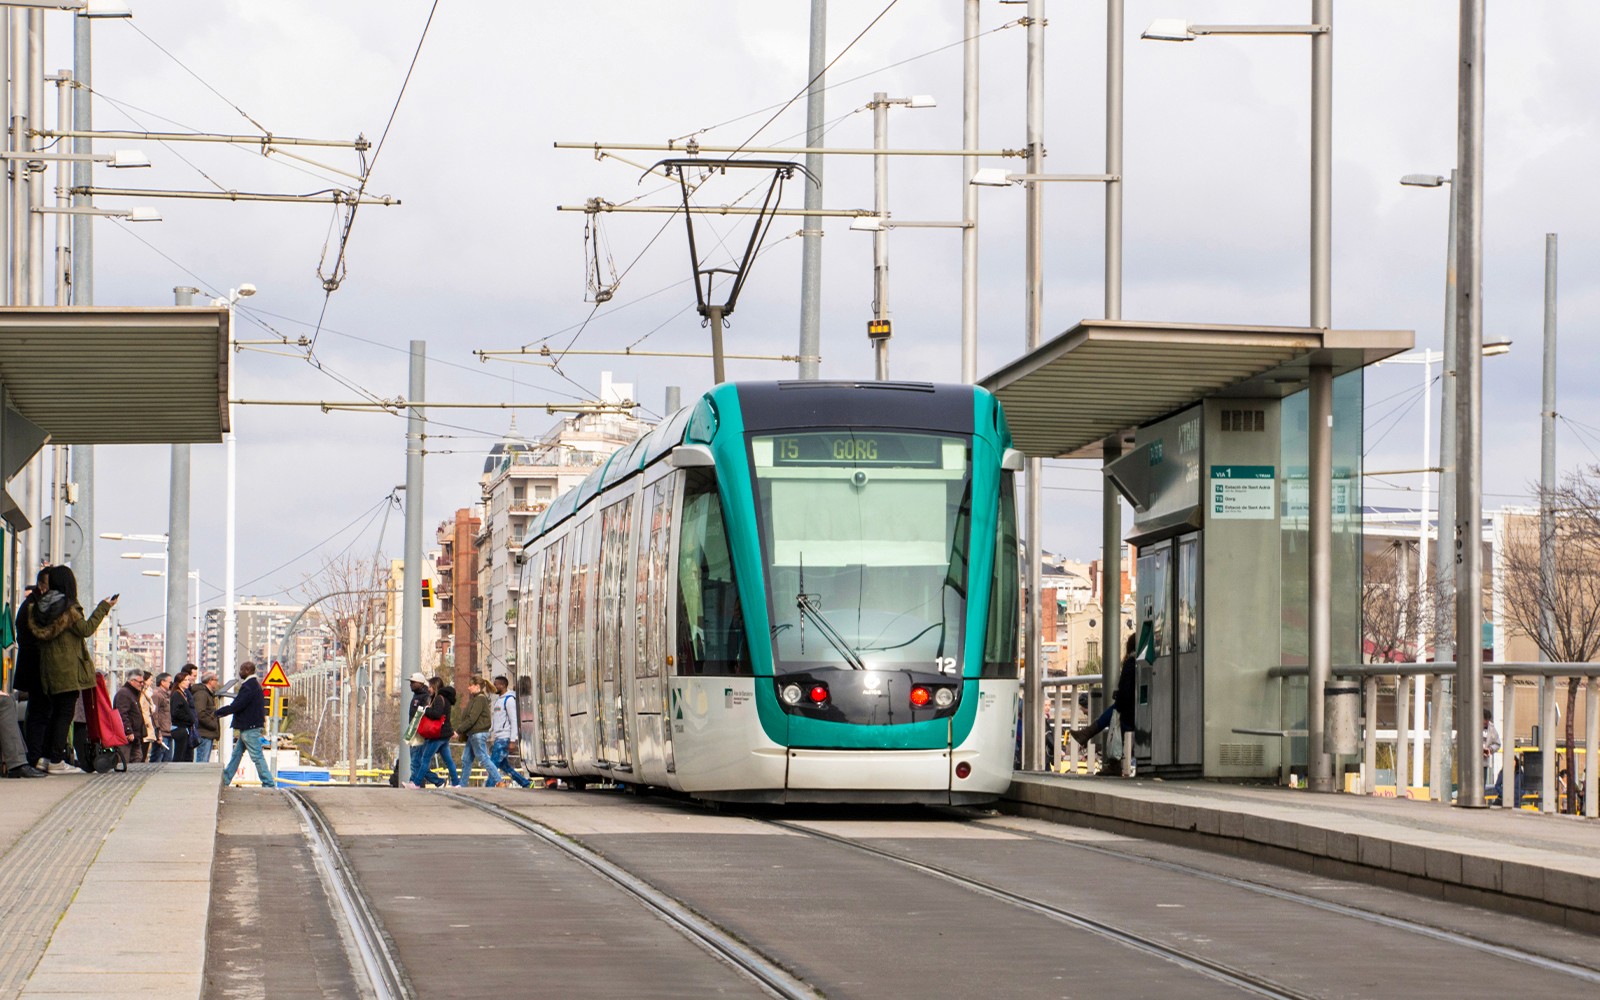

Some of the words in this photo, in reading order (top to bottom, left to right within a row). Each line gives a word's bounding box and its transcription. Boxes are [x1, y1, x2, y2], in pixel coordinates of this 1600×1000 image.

[779, 438, 799, 459] T5
[833, 439, 878, 460] GORG
[1226, 468, 1231, 478] 1
[935, 656, 957, 674] 12
